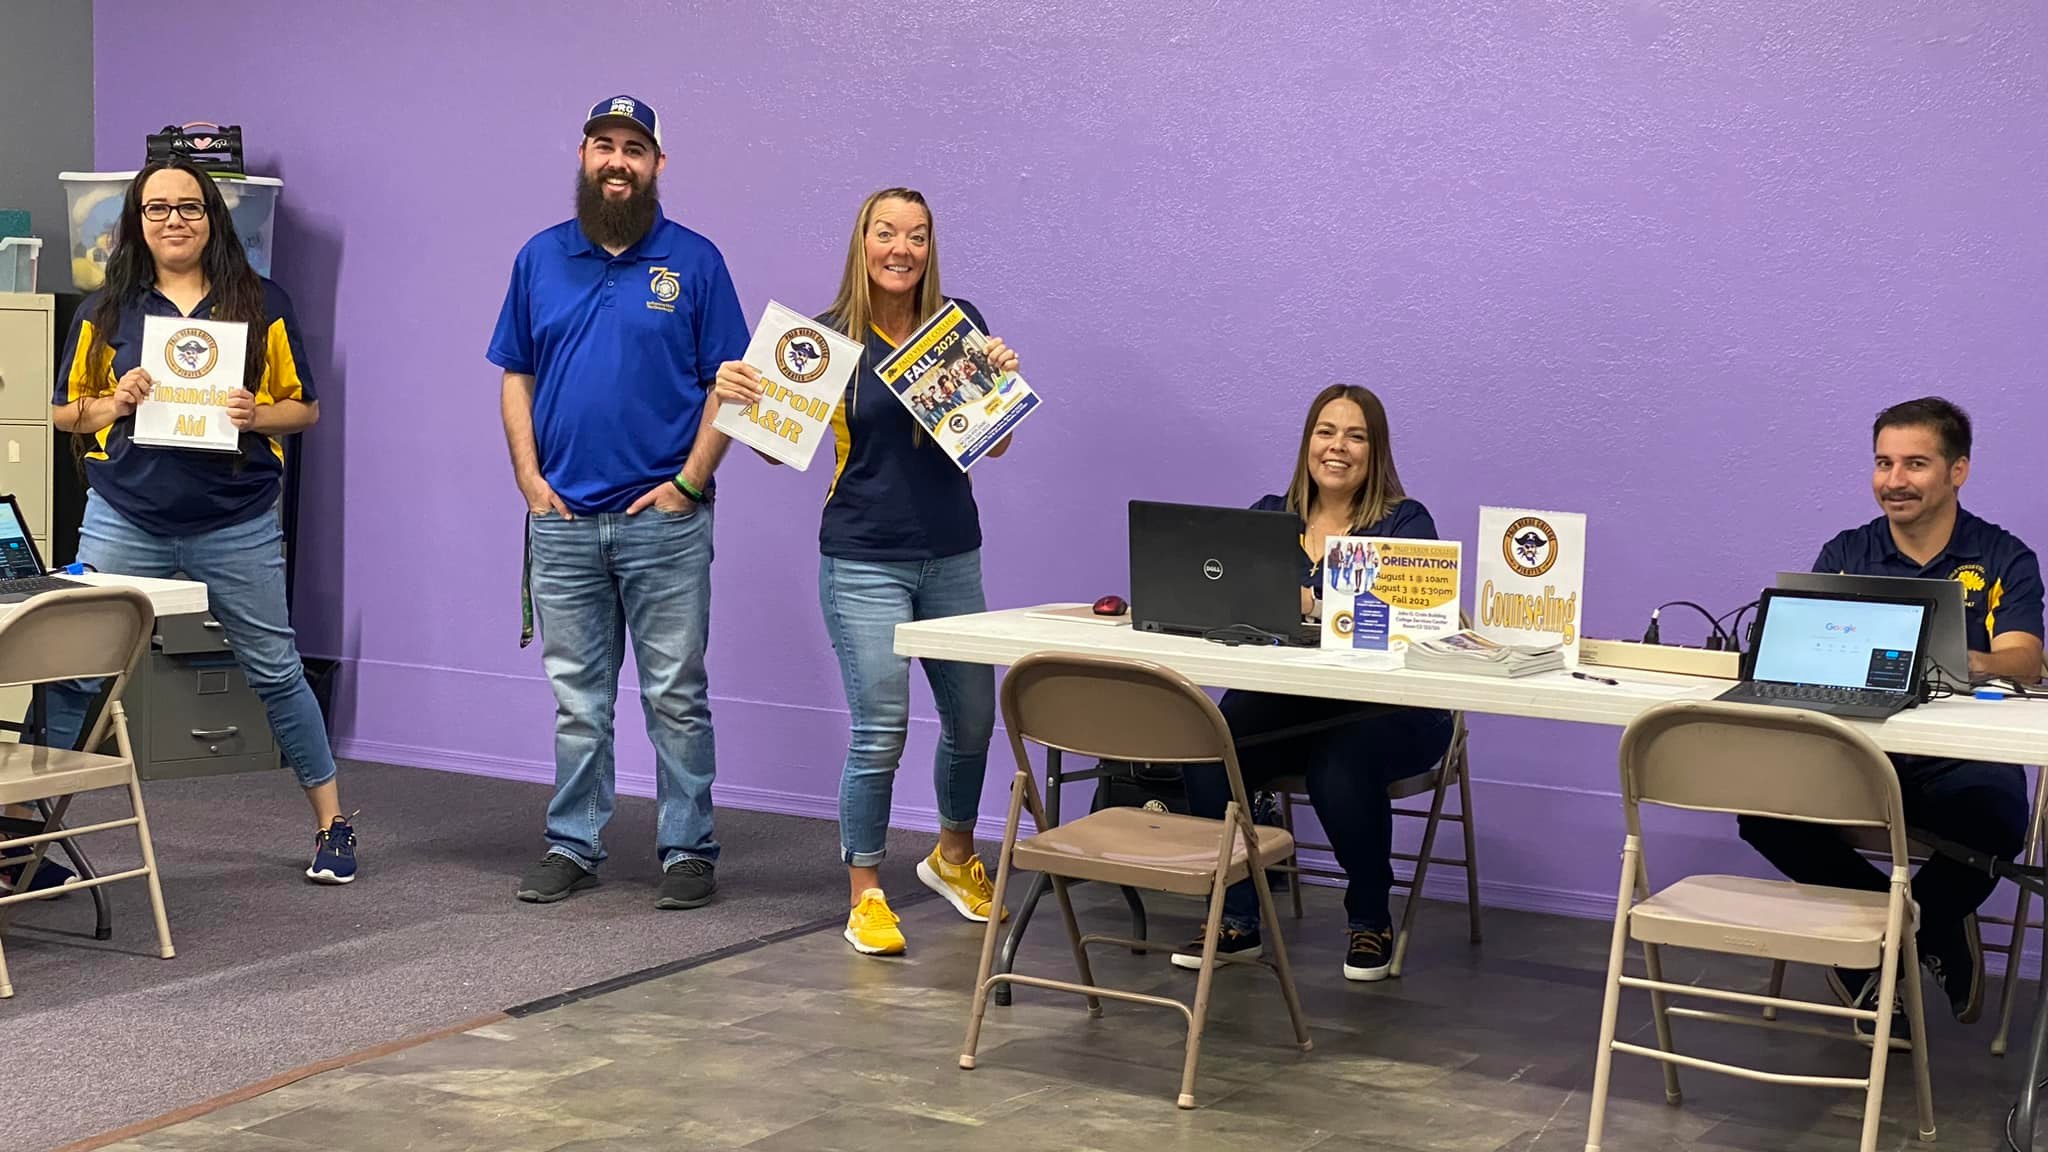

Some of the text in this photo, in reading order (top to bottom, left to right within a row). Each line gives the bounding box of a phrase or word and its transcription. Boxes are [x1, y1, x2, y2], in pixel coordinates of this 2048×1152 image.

[611, 103, 633, 113] PRO
[649, 266, 680, 302] 75
[904, 331, 960, 384] FALL 2023
[760, 377, 830, 422] nroll
[173, 414, 206, 437] Aid
[739, 400, 803, 444] A&R
[1382, 556, 1457, 569] ORIENTATION
[1376, 572, 1405, 582] August
[1371, 582, 1400, 592] August
[1402, 586, 1407, 594] 3
[1392, 595, 1407, 604] Fall
[1409, 597, 1430, 606] 2023
[1481, 579, 1576, 645] Counseling
[1826, 622, 1856, 633] Google
